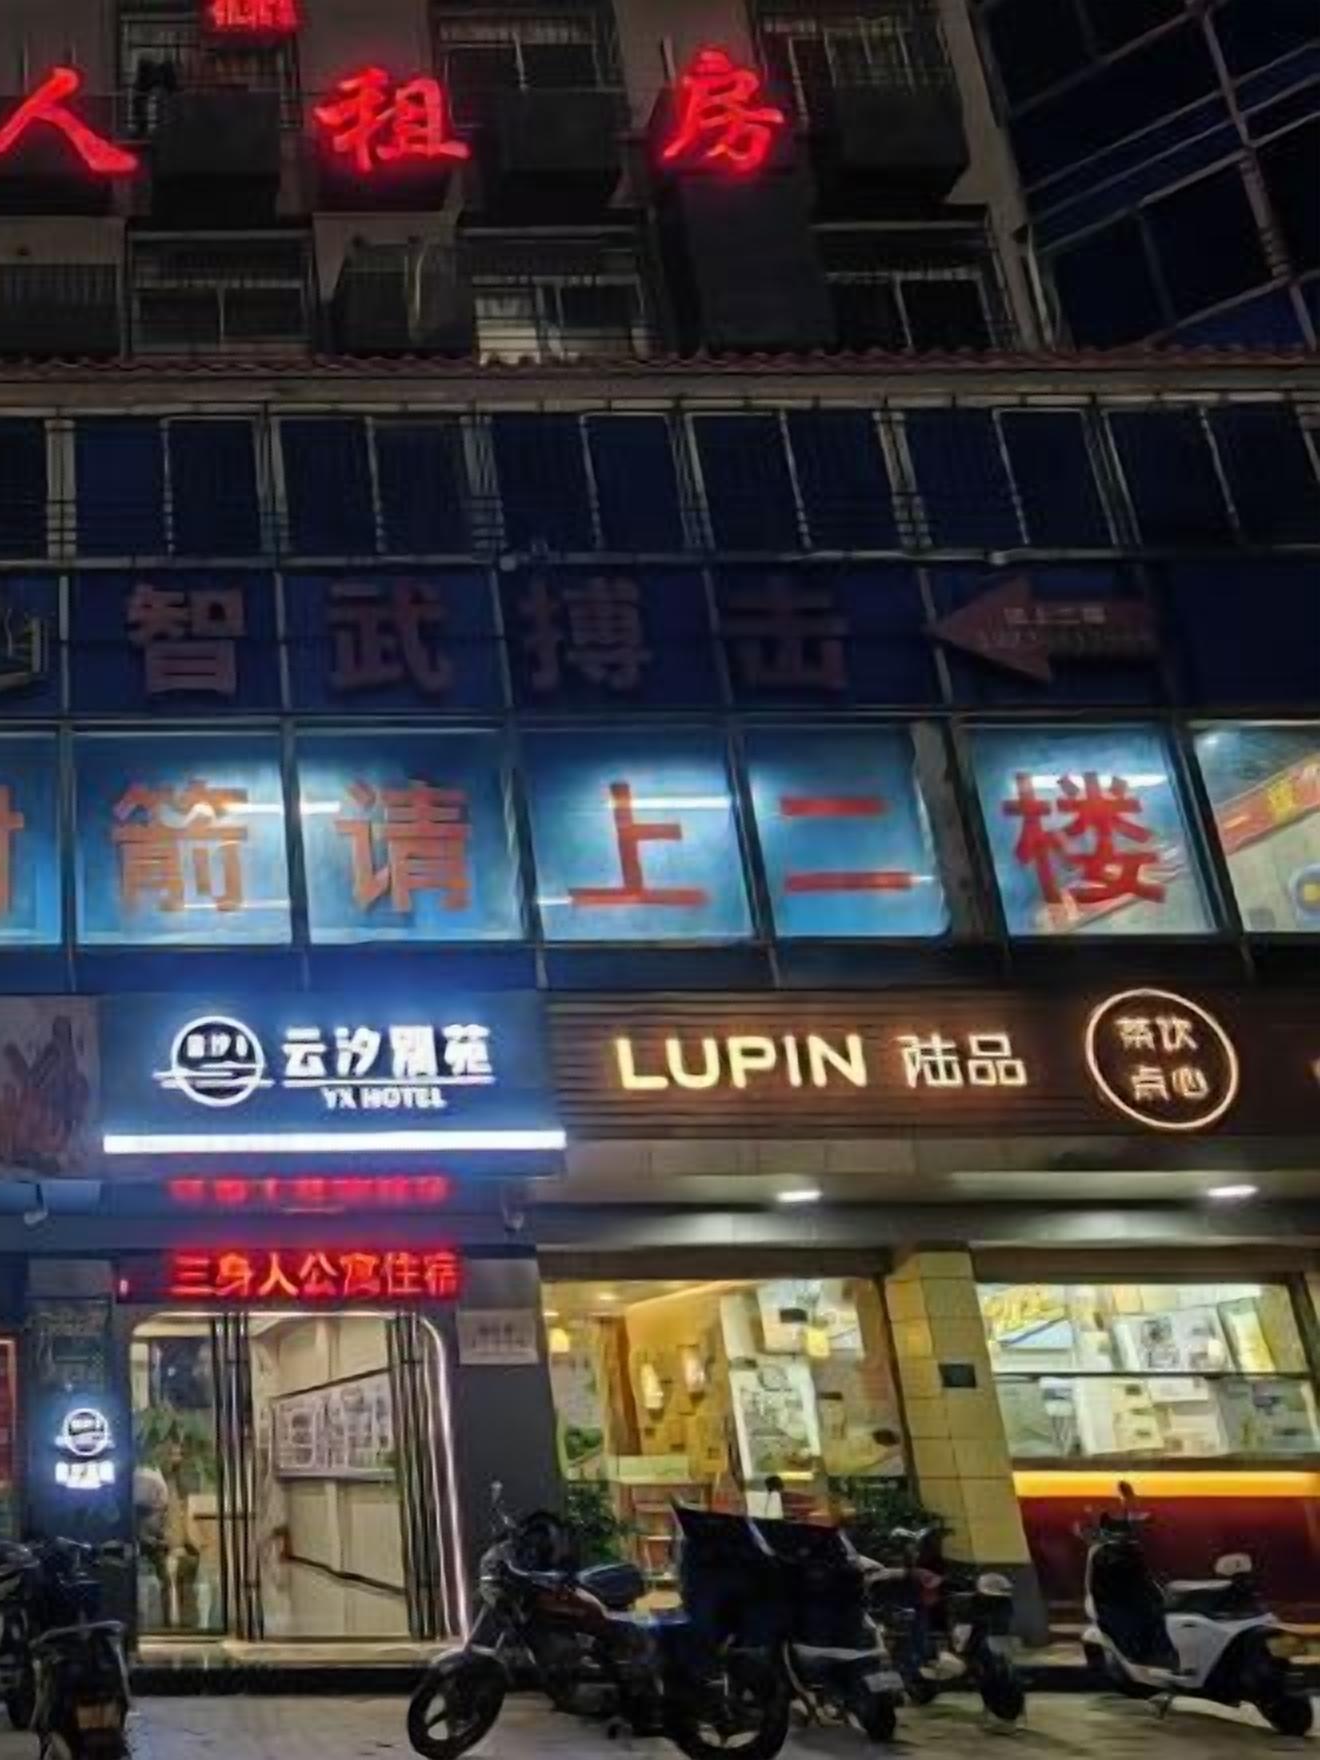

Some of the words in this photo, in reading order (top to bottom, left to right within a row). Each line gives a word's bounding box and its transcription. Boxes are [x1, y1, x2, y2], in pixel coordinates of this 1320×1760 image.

[126, 583, 848, 696] 智武搏击
[613, 1033, 867, 1090] LUPIN
[896, 1033, 1027, 1088] 陆品
[1131, 1065, 1209, 1101] 点心
[360, 1086, 447, 1109] HOTEL
[168, 1251, 458, 1297] 三身人公寓住宿
